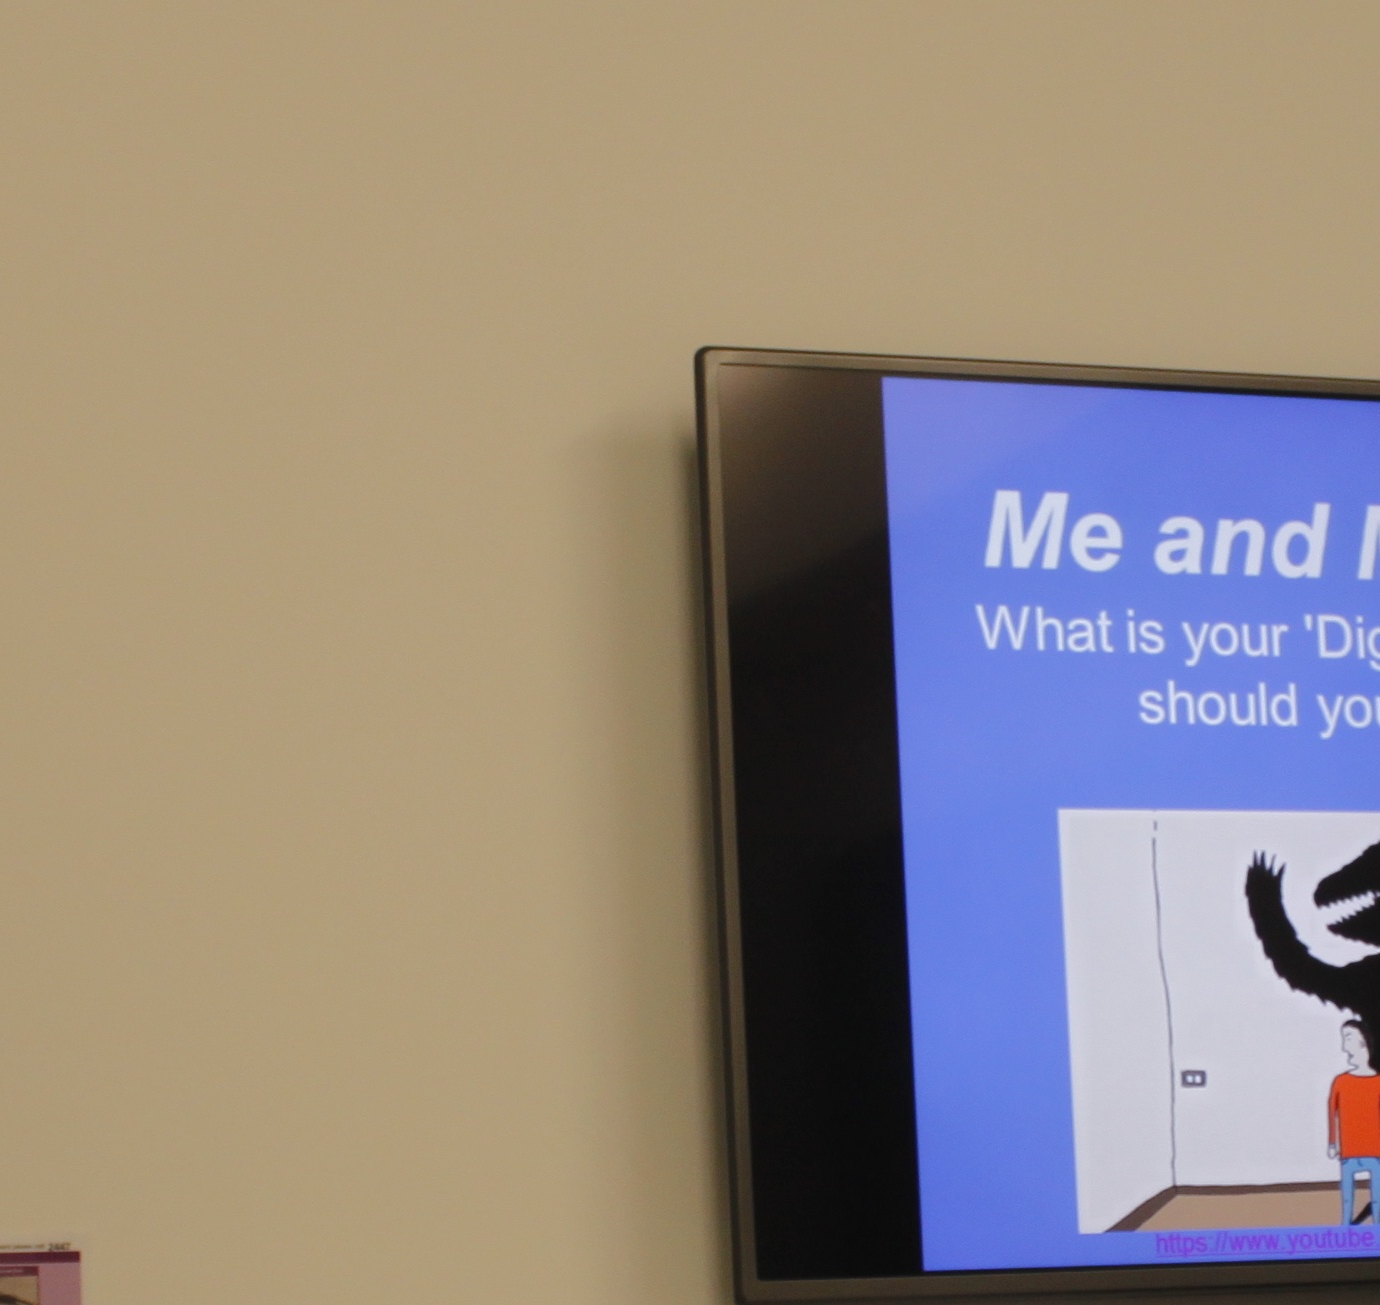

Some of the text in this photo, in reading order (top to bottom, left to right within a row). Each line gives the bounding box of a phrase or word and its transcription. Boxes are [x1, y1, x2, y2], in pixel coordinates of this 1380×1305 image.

[984, 489, 1123, 572] Me
[1154, 502, 1329, 579] and
[975, 604, 1114, 653] What
[1126, 609, 1165, 655] is
[1182, 620, 1289, 667] your
[1139, 680, 1298, 727] should
